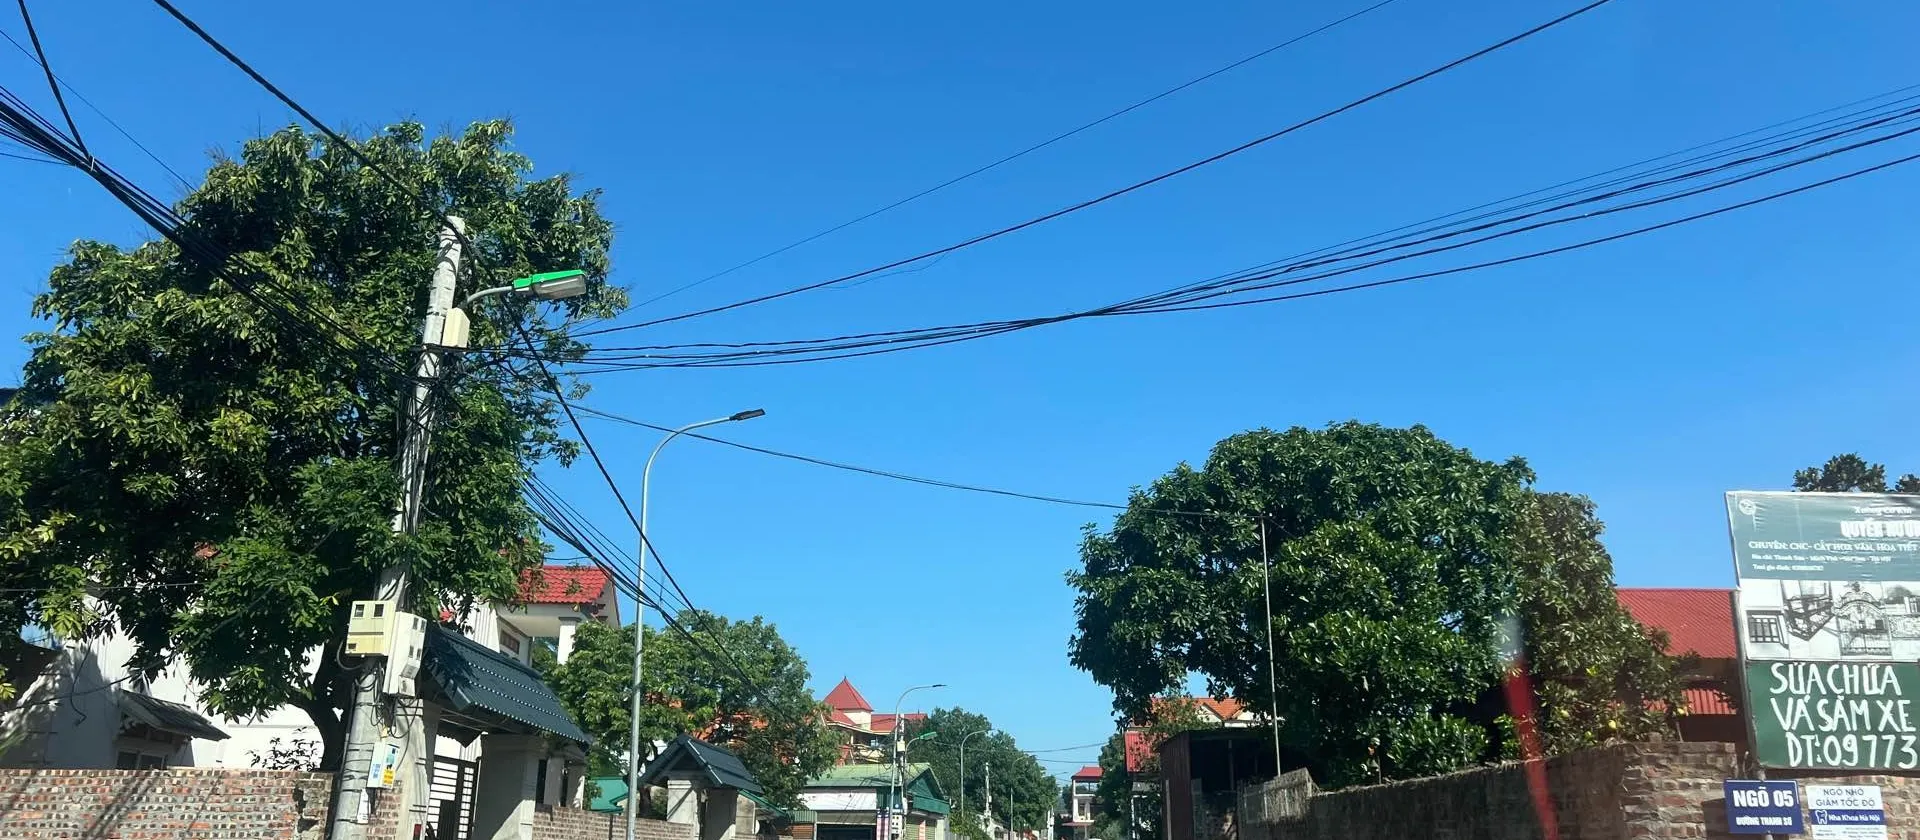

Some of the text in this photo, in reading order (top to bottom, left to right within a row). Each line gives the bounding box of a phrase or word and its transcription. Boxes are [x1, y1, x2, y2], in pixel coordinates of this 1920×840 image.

[1876, 543, 1896, 551] HOA
[1827, 663, 1901, 695] CHỮA
[1770, 695, 1815, 731] VÁ
[1876, 699, 1916, 732] XE
[1733, 786, 1794, 807] NGÕ 05
